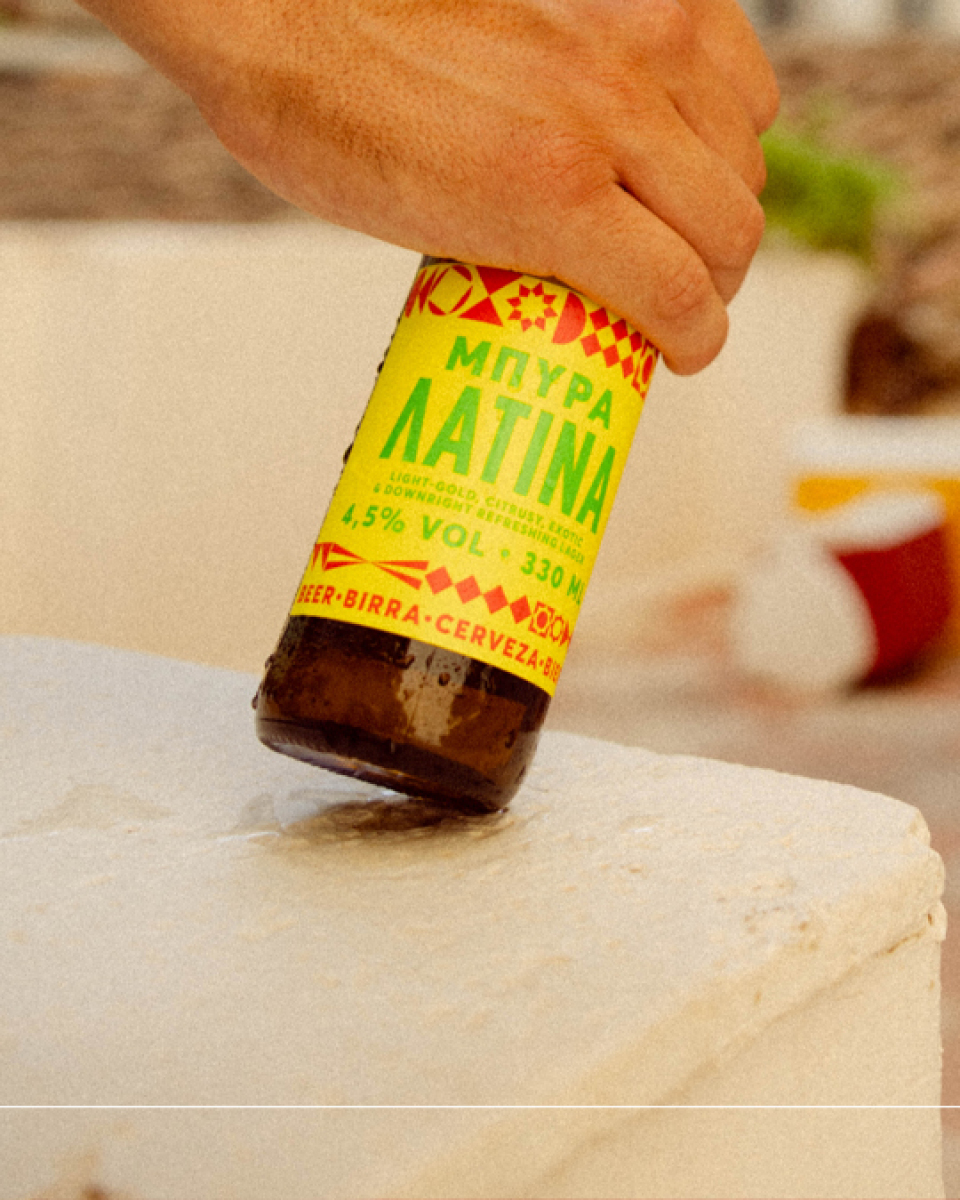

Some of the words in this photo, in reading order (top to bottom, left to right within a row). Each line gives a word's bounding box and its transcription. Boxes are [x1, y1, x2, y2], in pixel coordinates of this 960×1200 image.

[445, 335, 613, 431] ΜΠΥΡΑ
[341, 502, 406, 534] 4,5%
[422, 514, 485, 558] VOL
[520, 550, 565, 589] 330
[384, 484, 473, 515] DOWNRIGHT
[475, 507, 558, 549] REFRESHING
[548, 519, 584, 548] EXOTIC
